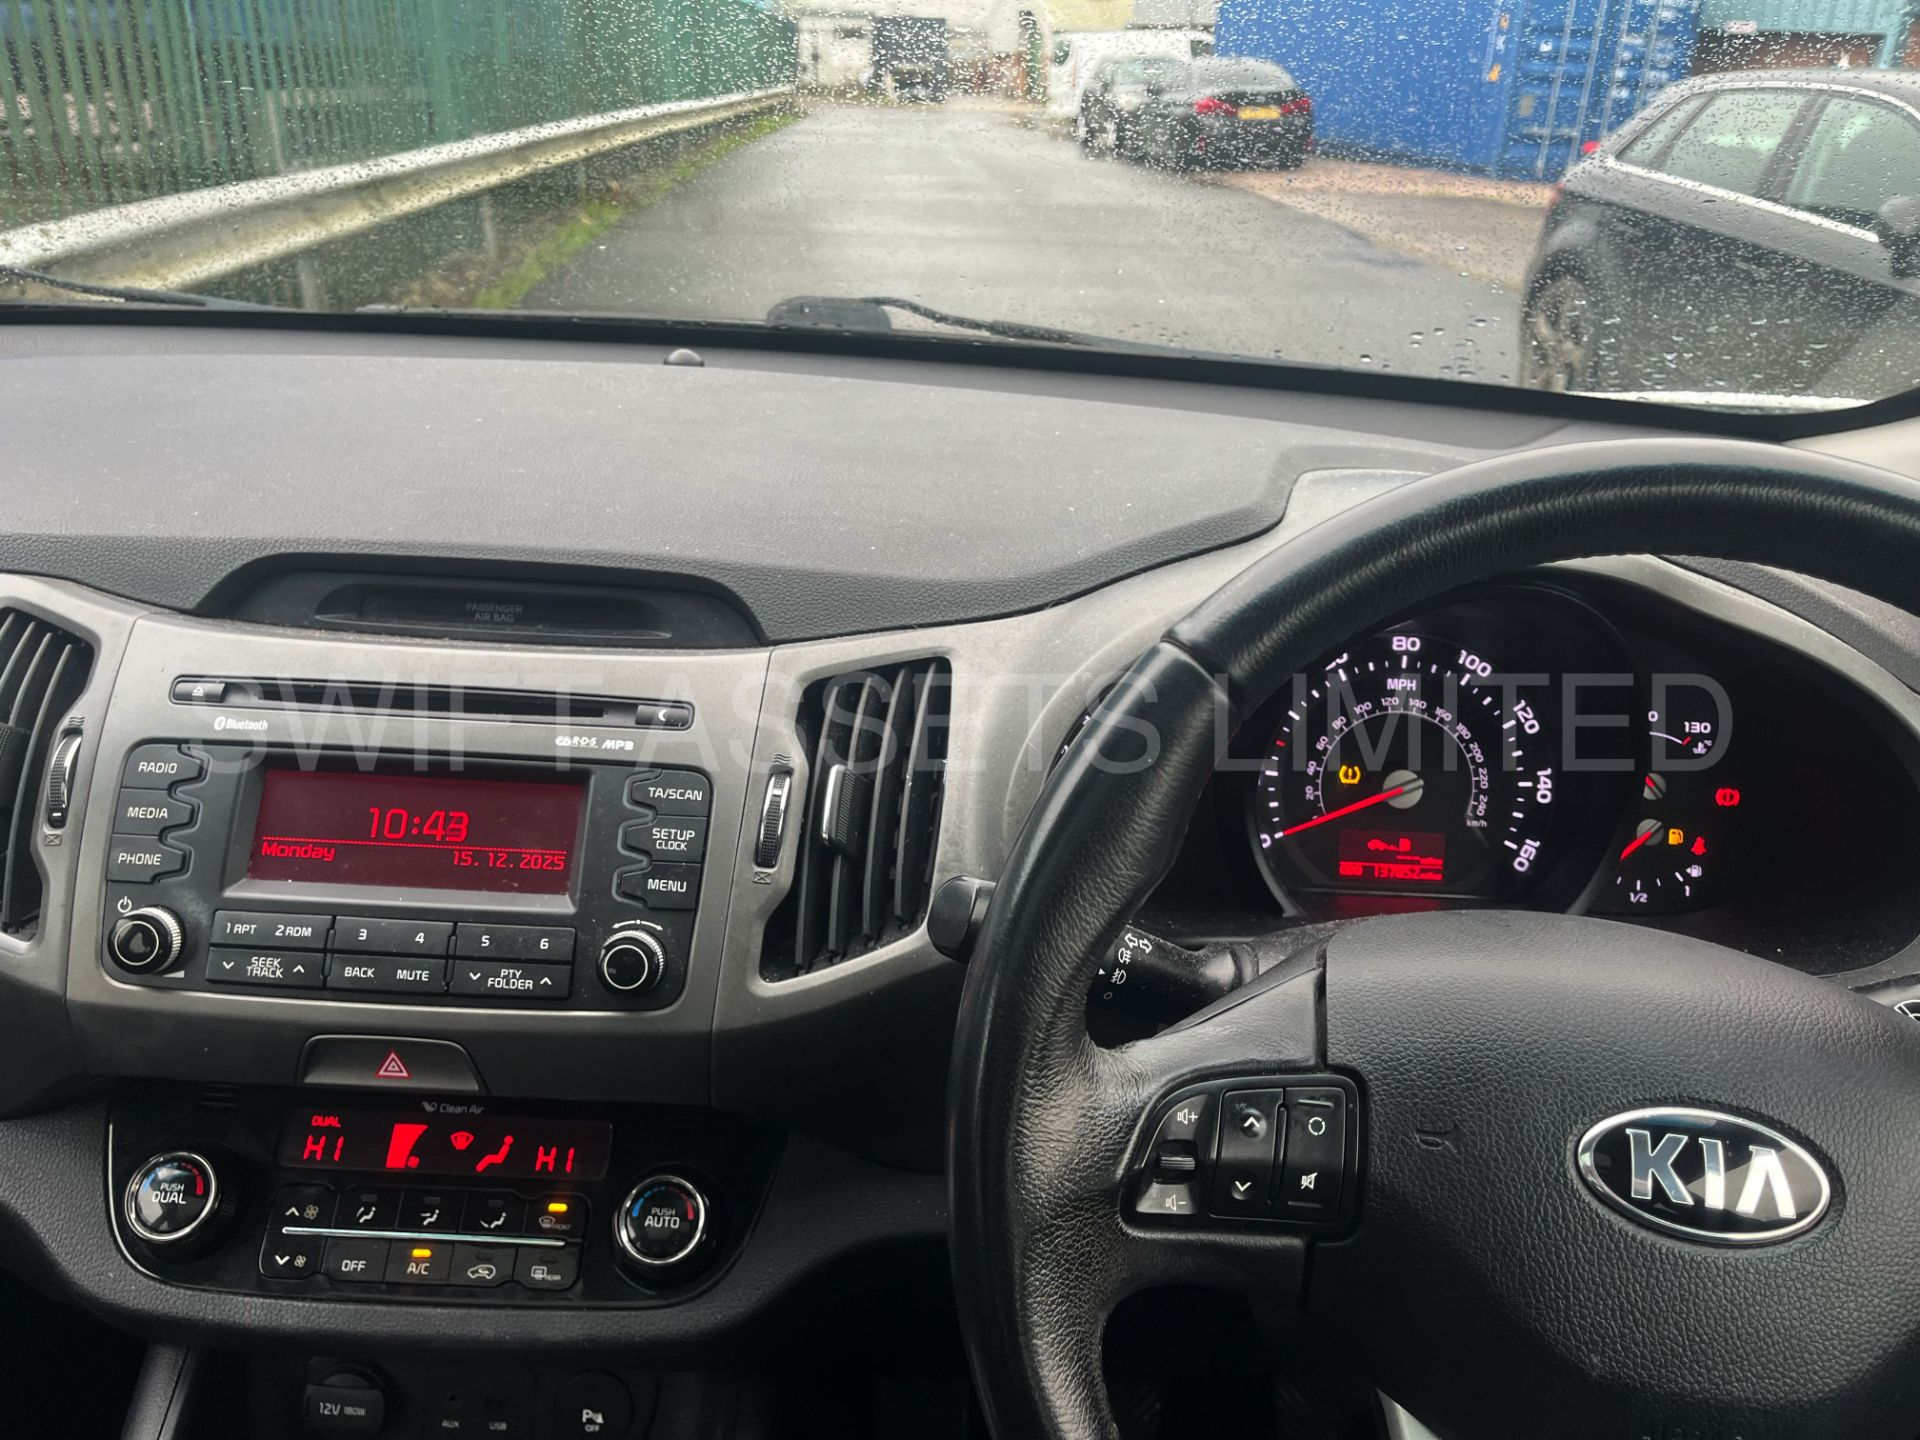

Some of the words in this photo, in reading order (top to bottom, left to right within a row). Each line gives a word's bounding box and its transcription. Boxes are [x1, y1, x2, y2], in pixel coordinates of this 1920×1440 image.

[1392, 636, 1421, 651] 80
[1458, 649, 1493, 678] 100
[1386, 678, 1417, 691] MPH
[1381, 697, 1399, 706] 120
[1409, 698, 1427, 710] 140
[1353, 702, 1372, 715] 100
[1435, 706, 1453, 722] 160
[1331, 715, 1347, 730] 80
[1513, 699, 1540, 735] 120
[1648, 711, 1659, 722] 0
[225, 718, 268, 731] Bluetooth
[1456, 722, 1472, 740] 180
[1684, 721, 1712, 734] 130
[1315, 735, 1329, 751] 60
[1469, 741, 1484, 763] 200
[138, 762, 177, 774] RADIO
[1306, 760, 1317, 776] 40
[1478, 767, 1489, 789] 220
[1536, 767, 1553, 804] 140
[648, 787, 703, 801] TA/SCAN
[1305, 785, 1315, 800] 20
[1476, 794, 1489, 817] 240
[127, 807, 168, 819] MEDIA
[369, 807, 469, 843] 10:43
[1466, 819, 1488, 828] km/h
[652, 828, 695, 841] SETUP
[262, 841, 335, 862] Monday
[656, 840, 687, 851] CLOCK
[118, 852, 162, 865] PHONE
[1513, 838, 1541, 872] 160
[647, 879, 687, 892] MENU
[1685, 885, 1690, 897] 1
[1629, 892, 1648, 903] 1/2
[226, 922, 231, 933] 1
[233, 924, 257, 935] RPT
[275, 924, 284, 936] 2
[285, 926, 312, 937] RDM
[358, 928, 368, 940] 3
[414, 932, 425, 944] 4
[481, 935, 491, 947] 5
[539, 938, 549, 950] 6
[251, 956, 281, 968] SEEK
[246, 966, 283, 979] TRACK
[344, 967, 375, 978] BACK
[396, 969, 430, 982] MUTE
[500, 968, 522, 979] PTY
[487, 977, 533, 990] FOLDER
[439, 1103, 470, 1114] Clean
[471, 1104, 485, 1115] Air
[311, 1115, 341, 1128] DUAL
[1625, 1128, 1796, 1219] KIA
[160, 1183, 185, 1192] PUSH
[151, 1191, 186, 1205] DUAL
[651, 1207, 675, 1216] PUSH
[644, 1215, 680, 1229] AUTO
[341, 1260, 367, 1272] OFF
[407, 1263, 431, 1275] A/C
[319, 1402, 341, 1417] 12V
[441, 1419, 460, 1428] AUX
[488, 1421, 507, 1431] USB
